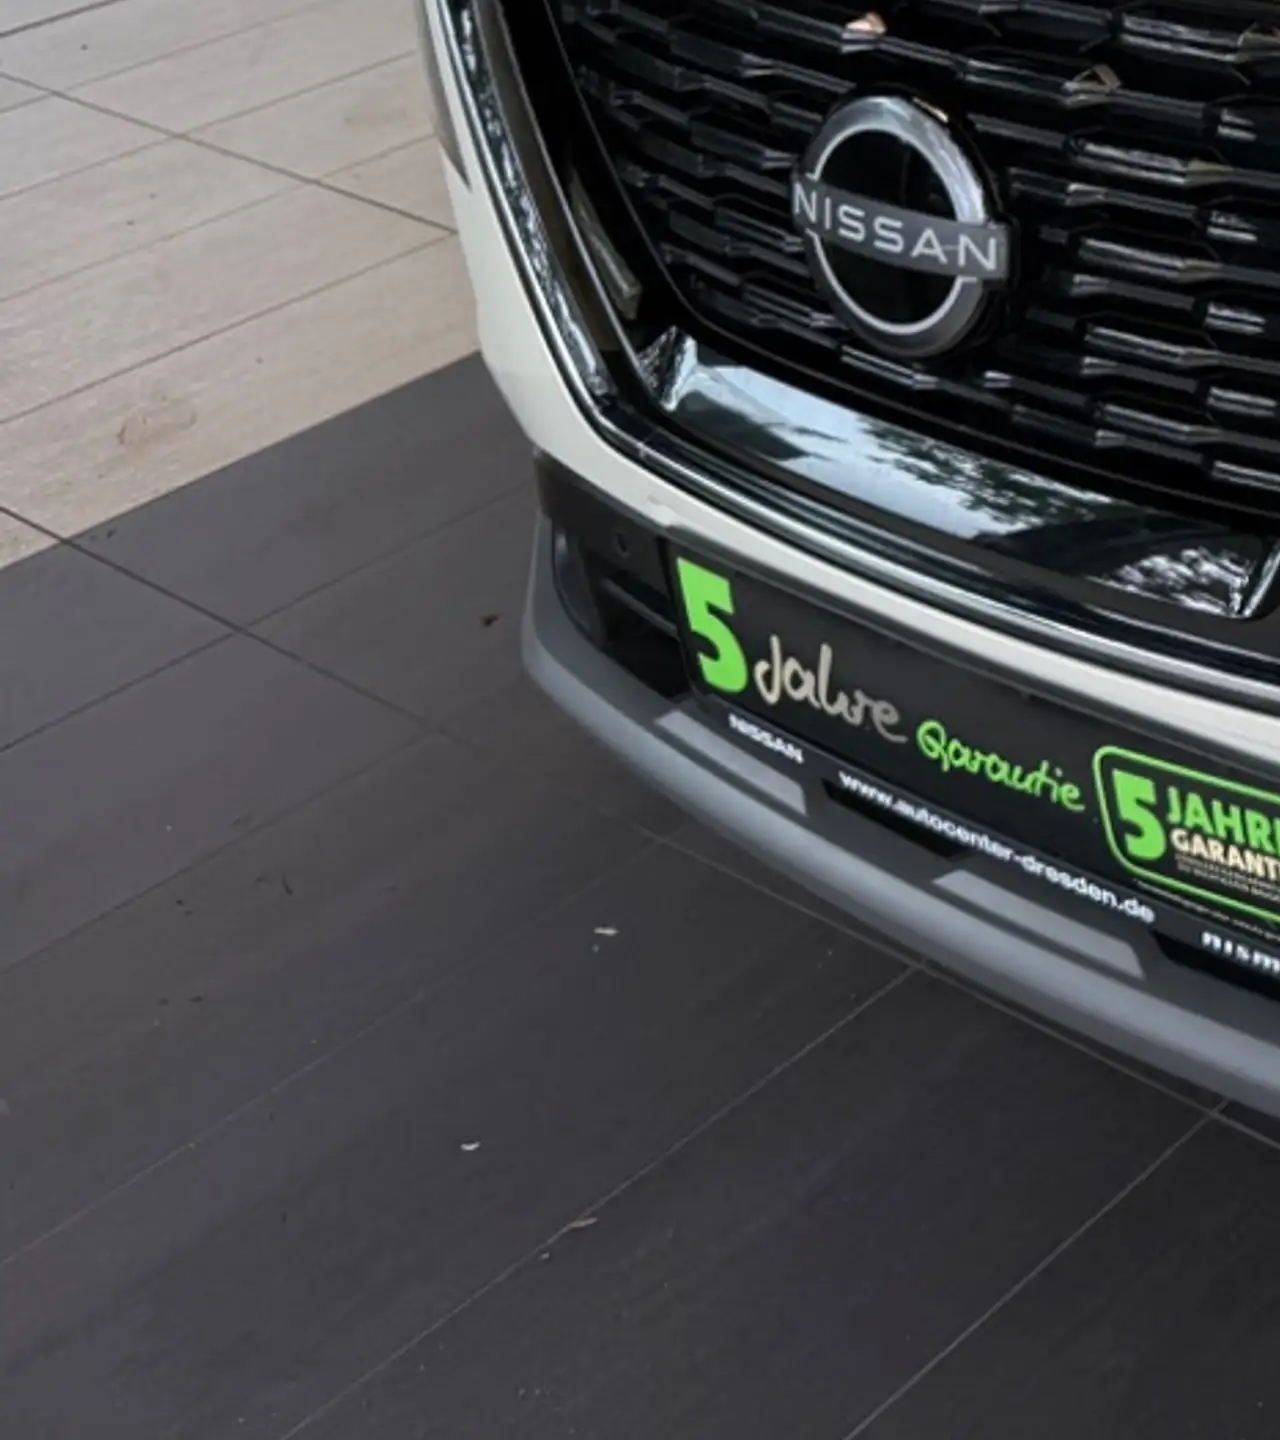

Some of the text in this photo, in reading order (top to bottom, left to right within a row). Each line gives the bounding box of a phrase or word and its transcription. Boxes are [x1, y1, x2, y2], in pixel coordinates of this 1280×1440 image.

[793, 180, 996, 271] NISSAN
[677, 556, 749, 693] 5
[754, 634, 909, 744] Jahre
[837, 769, 1157, 924] www.autocenter-dresden.de
[1112, 767, 1167, 861] 5
